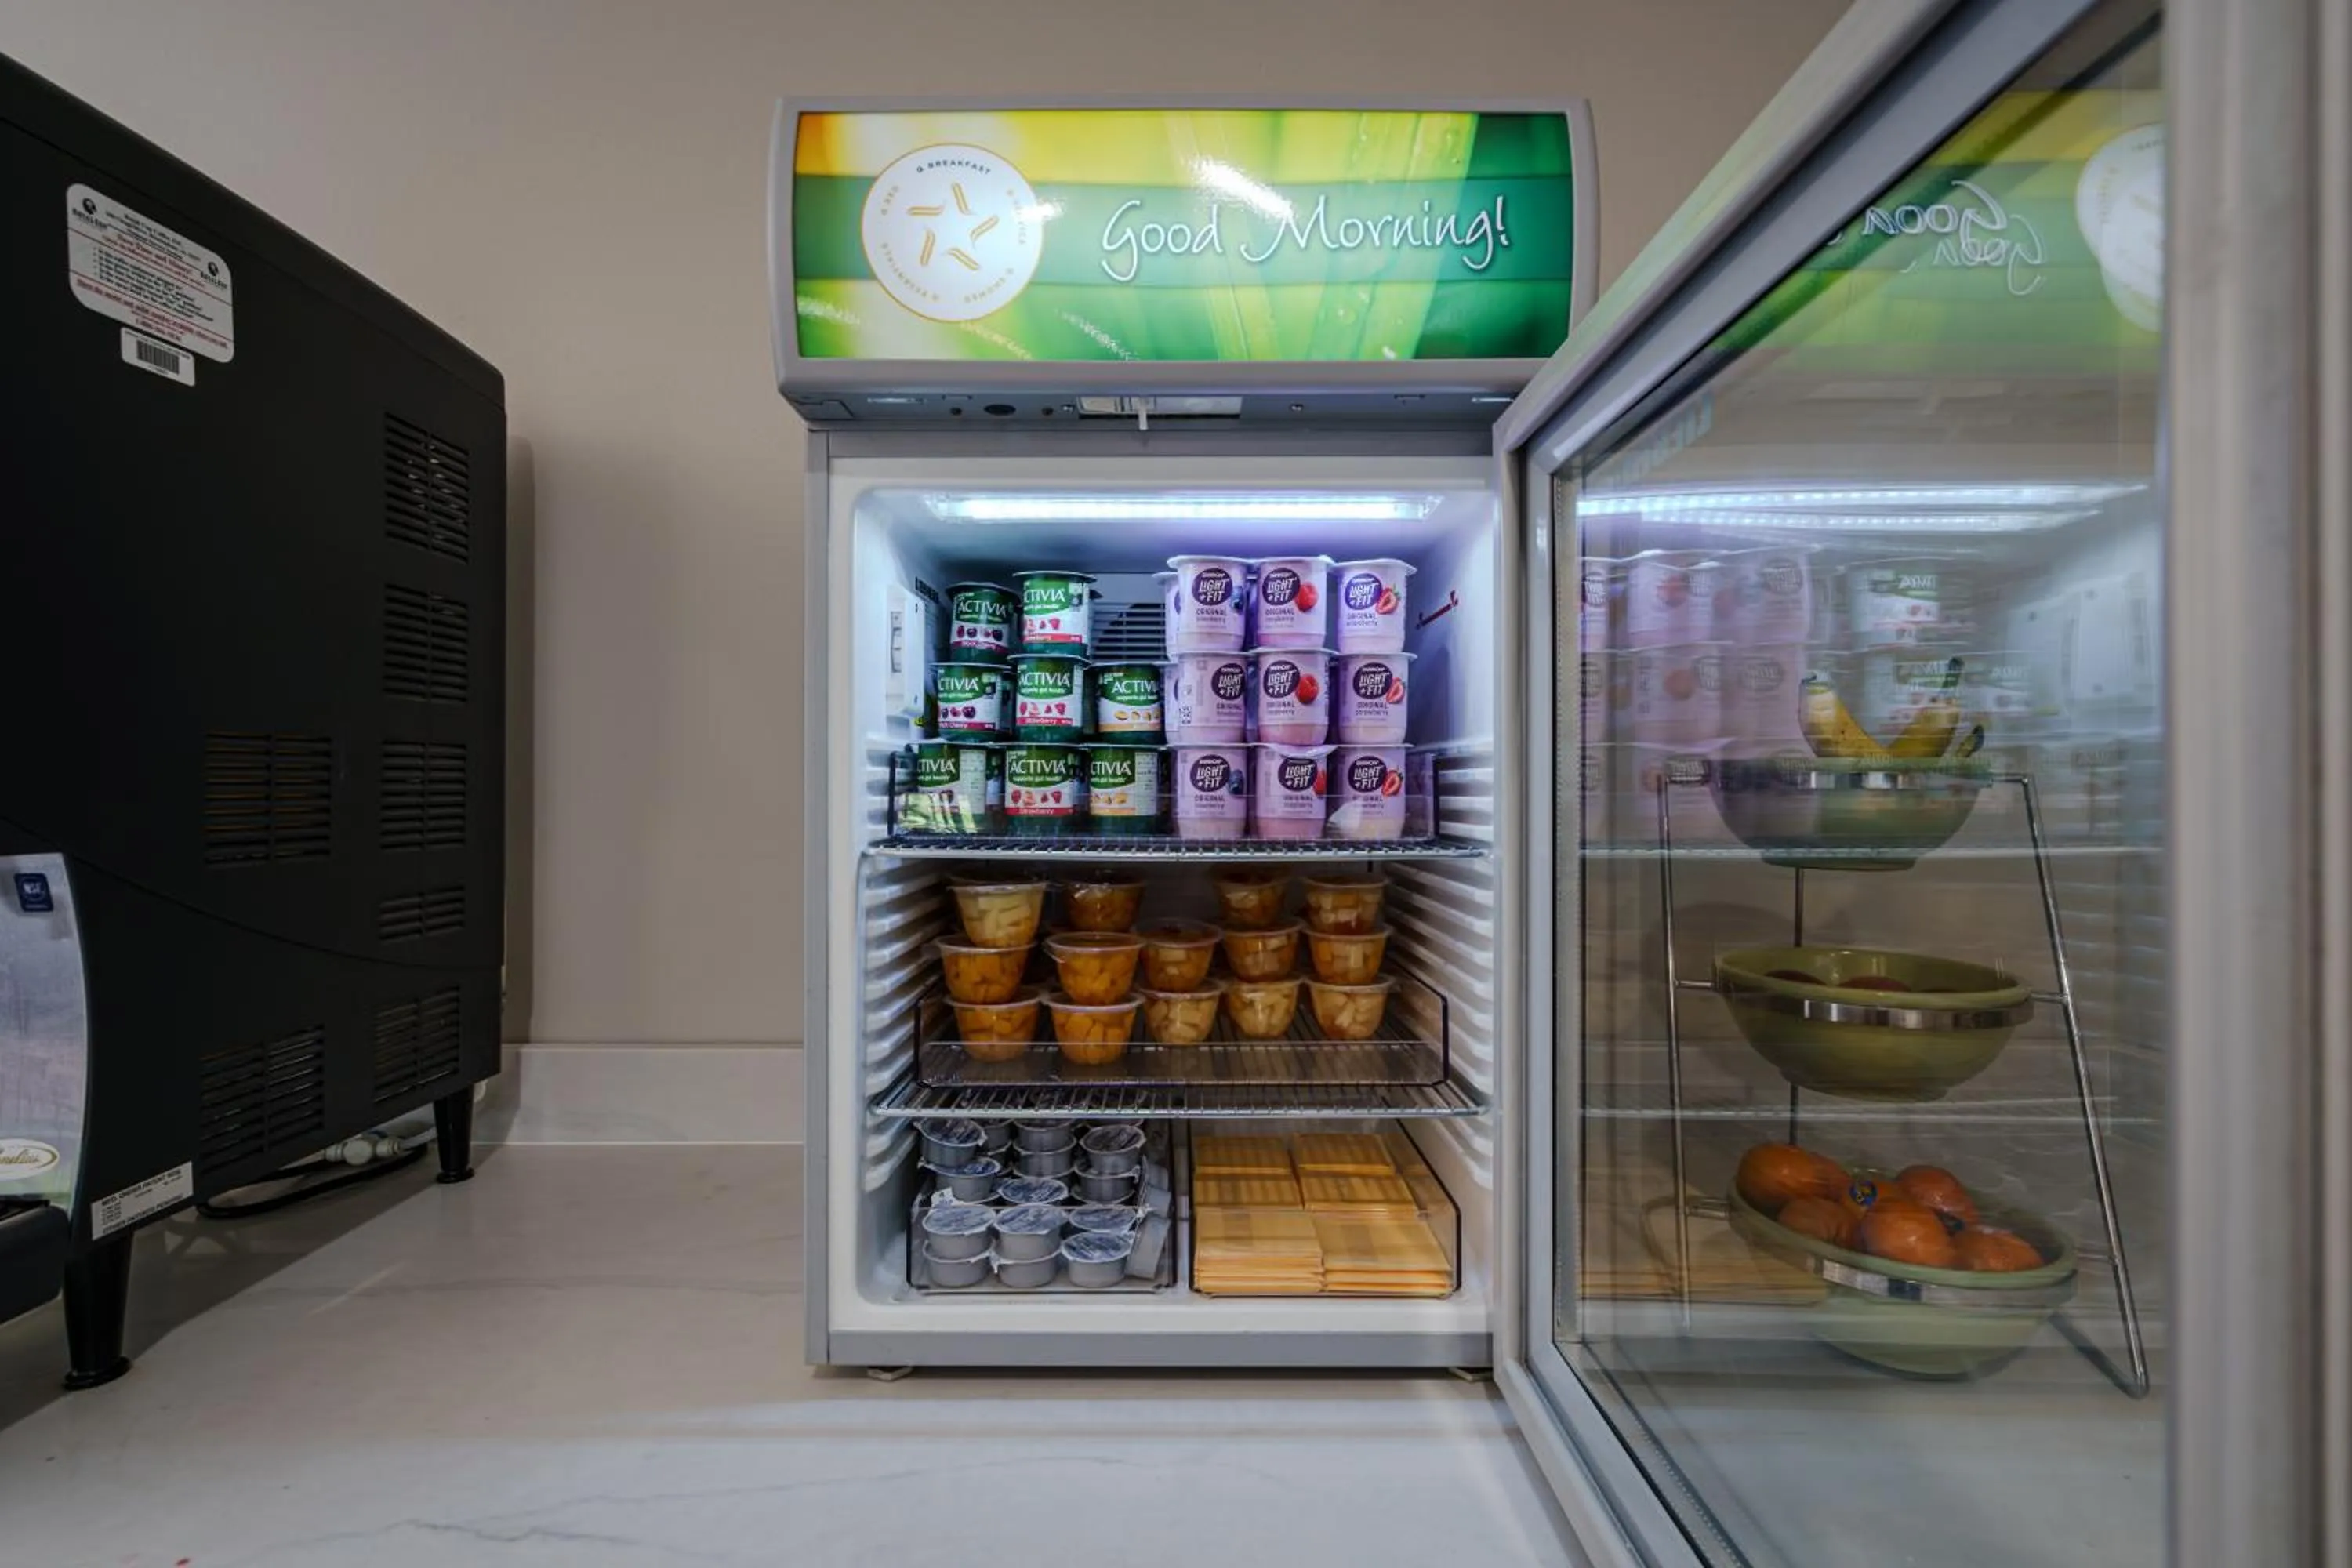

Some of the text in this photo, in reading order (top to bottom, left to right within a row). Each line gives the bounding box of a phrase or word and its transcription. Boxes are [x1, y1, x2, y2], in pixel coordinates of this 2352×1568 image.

[927, 159, 991, 174] BREAKFAST
[1100, 201, 1223, 281] Good
[1240, 194, 1510, 269] Morning!
[1199, 578, 1229, 593] LIGHT
[1267, 577, 1297, 593] LIGHT
[1349, 583, 1379, 597] LIGHT
[1023, 588, 1065, 603] CTIVIA
[957, 599, 1007, 618] ACTIVIA
[938, 677, 979, 691] CTIVIA
[1018, 671, 1071, 688] ACTIVIA
[1218, 673, 1243, 687] LIGHT
[1266, 670, 1297, 685] LIGHT
[1359, 672, 1390, 688] LIGHT
[1111, 679, 1157, 694] ACTIV
[916, 757, 956, 774] CTIVIA
[1010, 759, 1067, 775] ACTIVIA
[1090, 761, 1132, 775] CTIVIA
[1196, 764, 1228, 780] LIGHT
[1285, 764, 1315, 779] LIGHT
[1353, 765, 1385, 780] LIGHT
